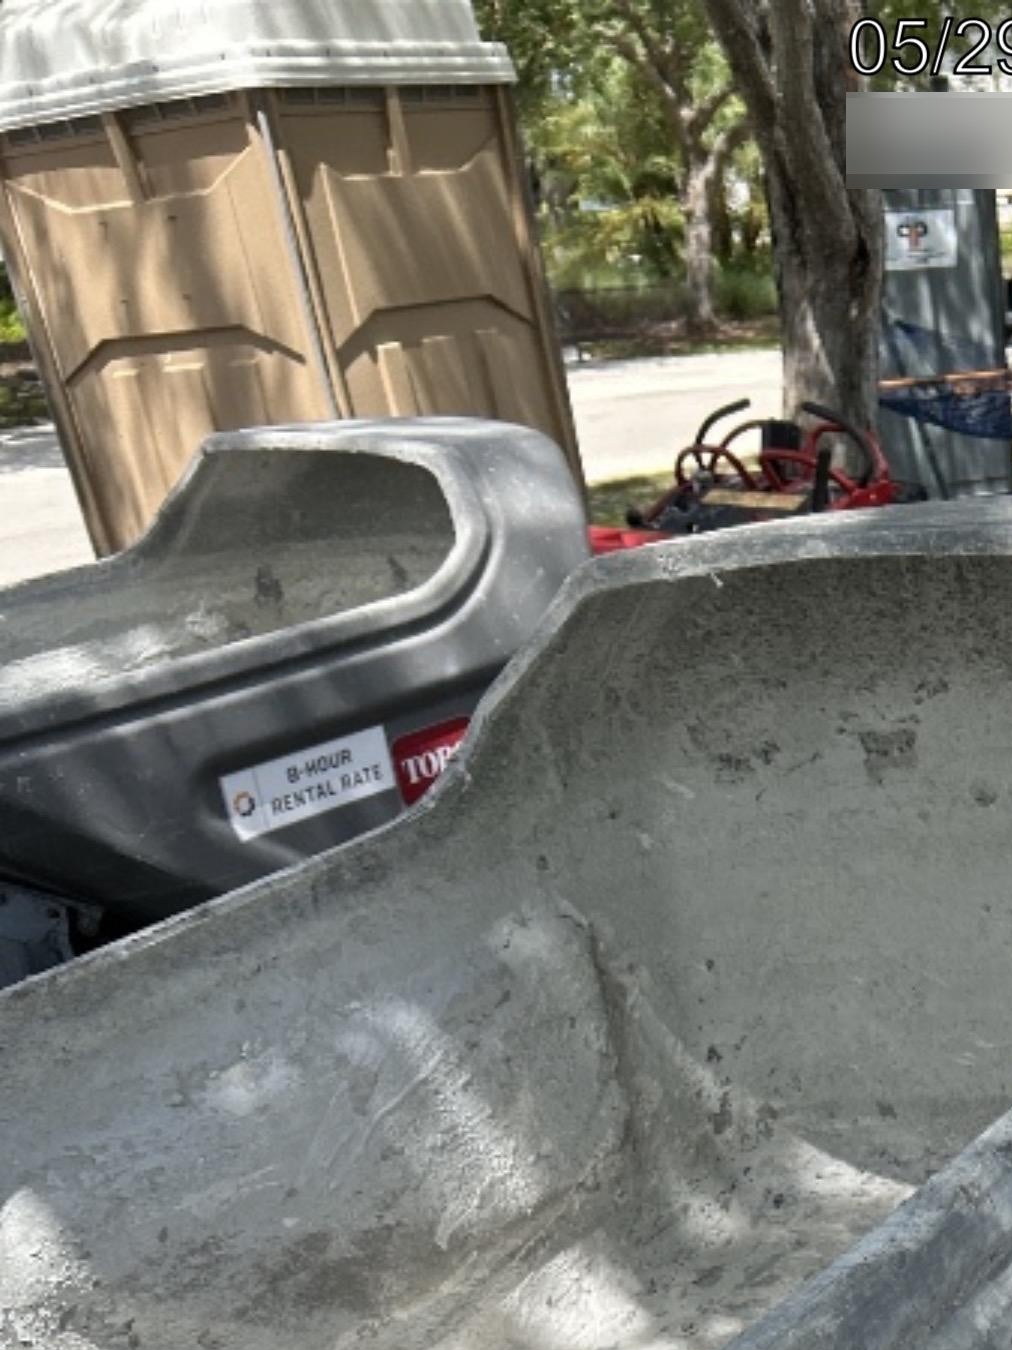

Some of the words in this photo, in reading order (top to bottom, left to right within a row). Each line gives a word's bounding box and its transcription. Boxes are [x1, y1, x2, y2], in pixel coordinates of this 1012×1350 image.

[286, 749, 352, 784] 8-HOUR
[271, 784, 335, 814] RENTAL
[341, 764, 383, 793] RATE
